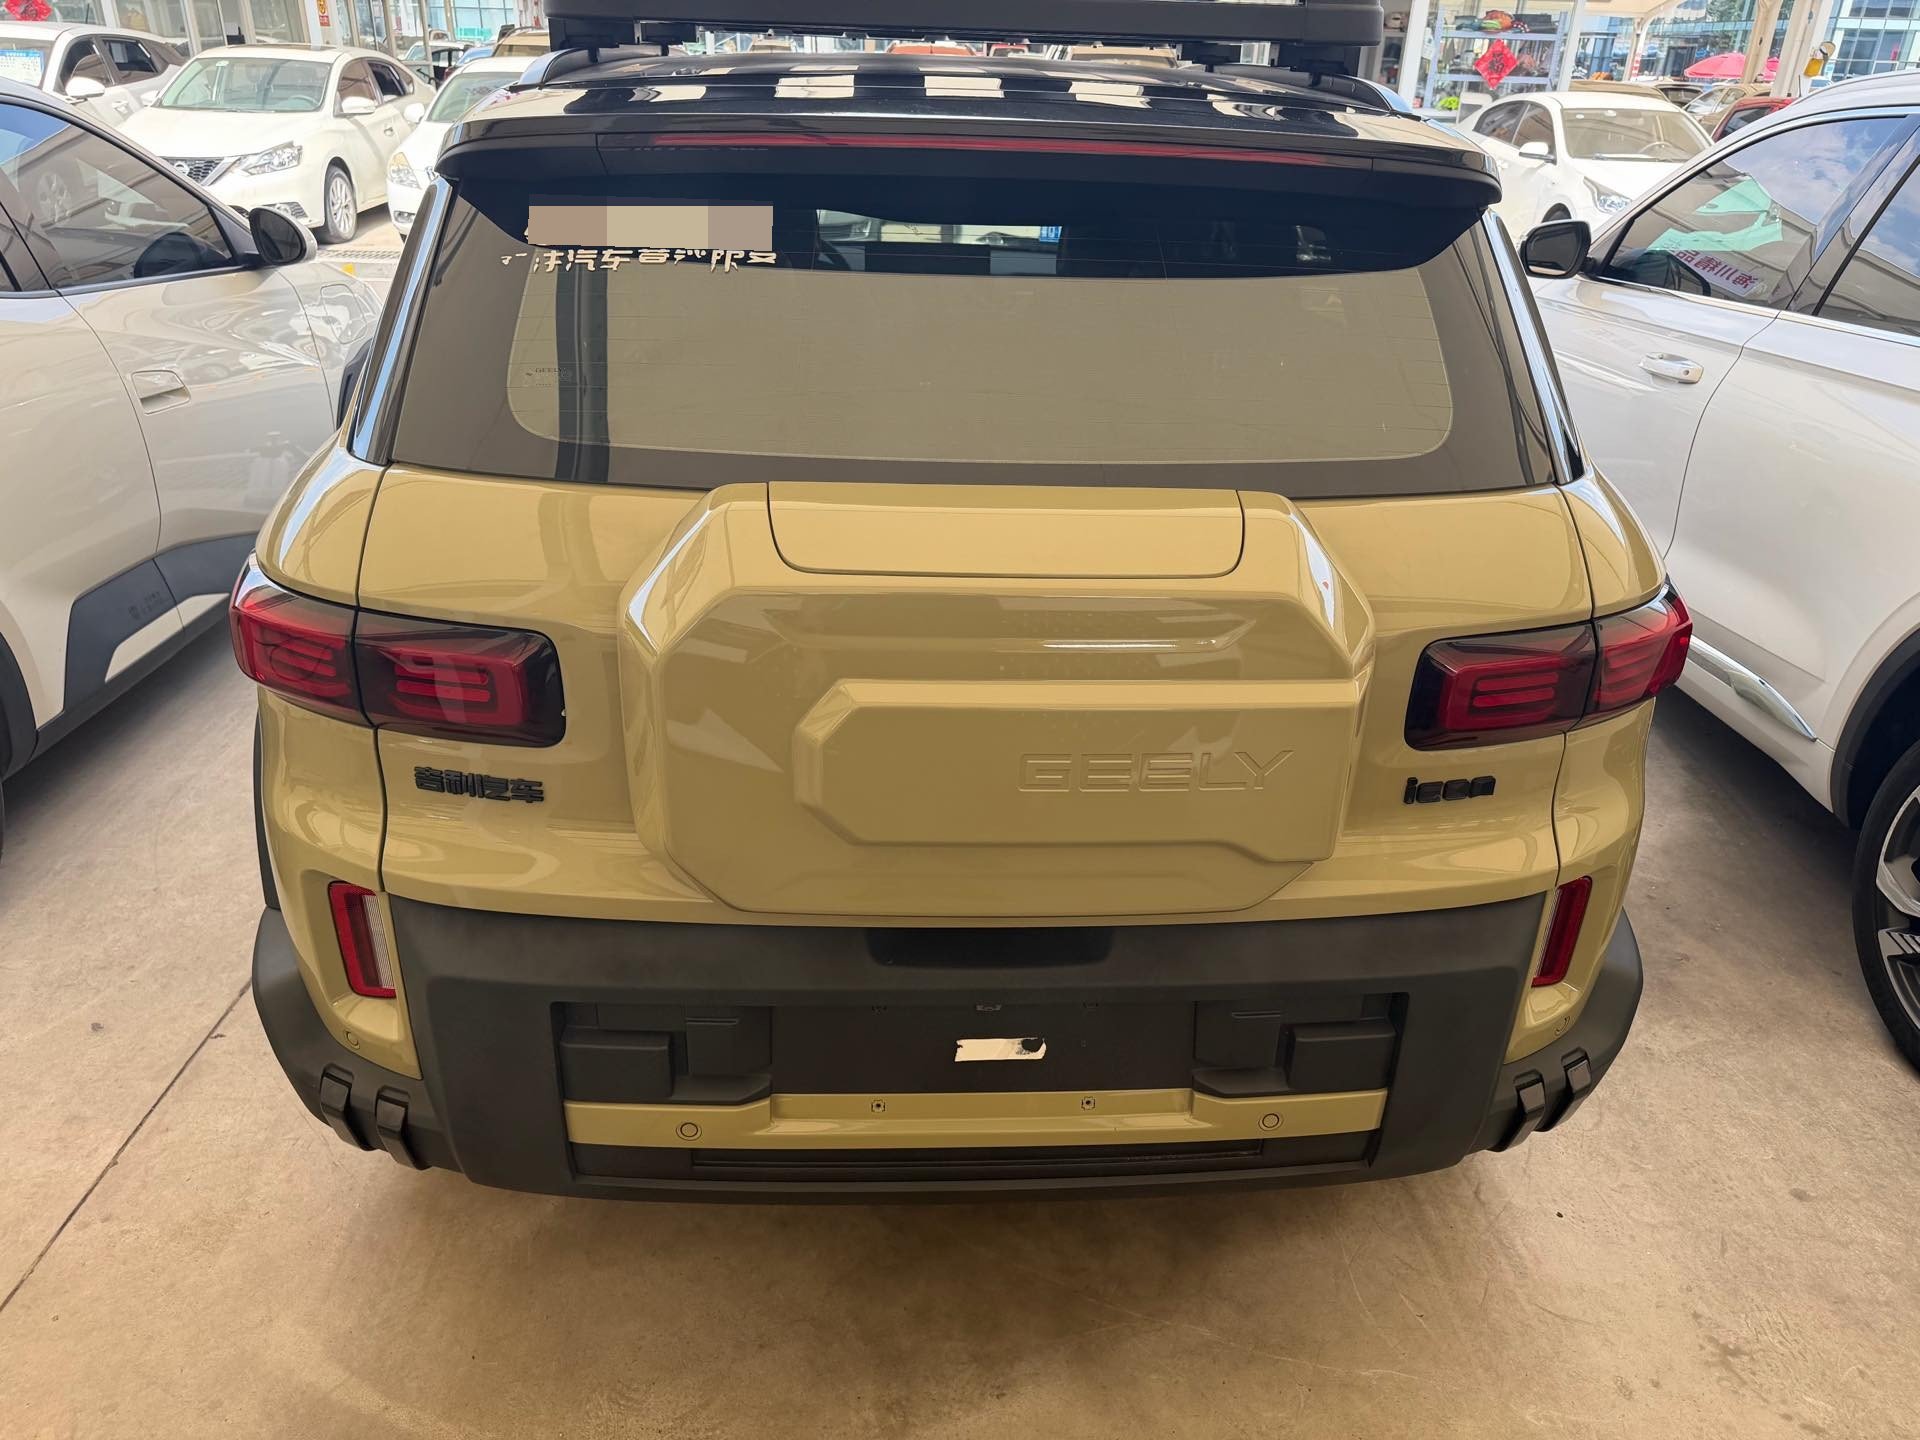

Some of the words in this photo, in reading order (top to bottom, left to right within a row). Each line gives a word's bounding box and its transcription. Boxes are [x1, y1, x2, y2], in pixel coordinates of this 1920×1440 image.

[414, 766, 544, 803] 吉利汽车
[1018, 750, 1294, 792] GEELY
